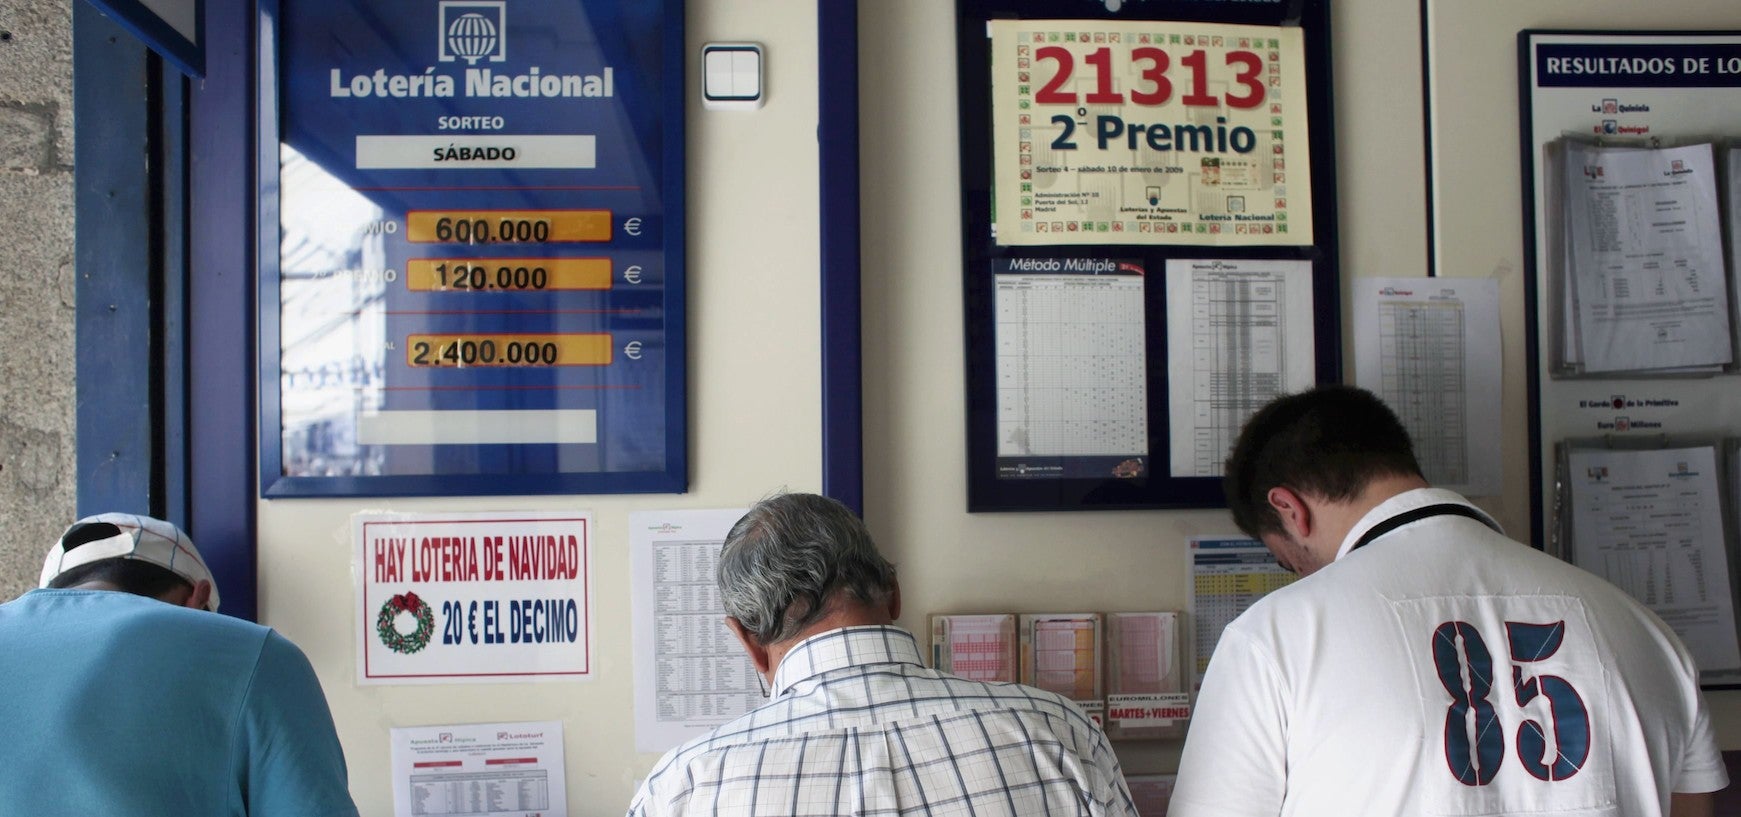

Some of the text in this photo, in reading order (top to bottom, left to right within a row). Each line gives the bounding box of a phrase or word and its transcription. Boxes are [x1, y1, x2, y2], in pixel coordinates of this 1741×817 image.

[1035, 46, 1266, 109] 21313
[1547, 57, 1675, 74] RESULTADOS
[1683, 57, 1709, 74] DE
[330, 67, 613, 97] Lotería Nacional
[438, 116, 504, 129] SORTEO
[1097, 115, 1256, 153] Premio
[433, 144, 516, 161] SÁBADO
[436, 217, 549, 242] 600.000
[624, 217, 642, 236] €
[1235, 213, 1275, 221] Nacional
[436, 263, 547, 289] 120.000
[624, 265, 642, 284] €
[1009, 258, 1060, 271] Método
[1064, 258, 1116, 275] Múltiple
[413, 340, 557, 365] 2.400.000
[624, 341, 642, 360] €
[375, 535, 578, 583] HAY LOTERIA DE NAVIDAD
[442, 598, 578, 644] 20 € EL DECIMO
[1432, 620, 1590, 786] 85
